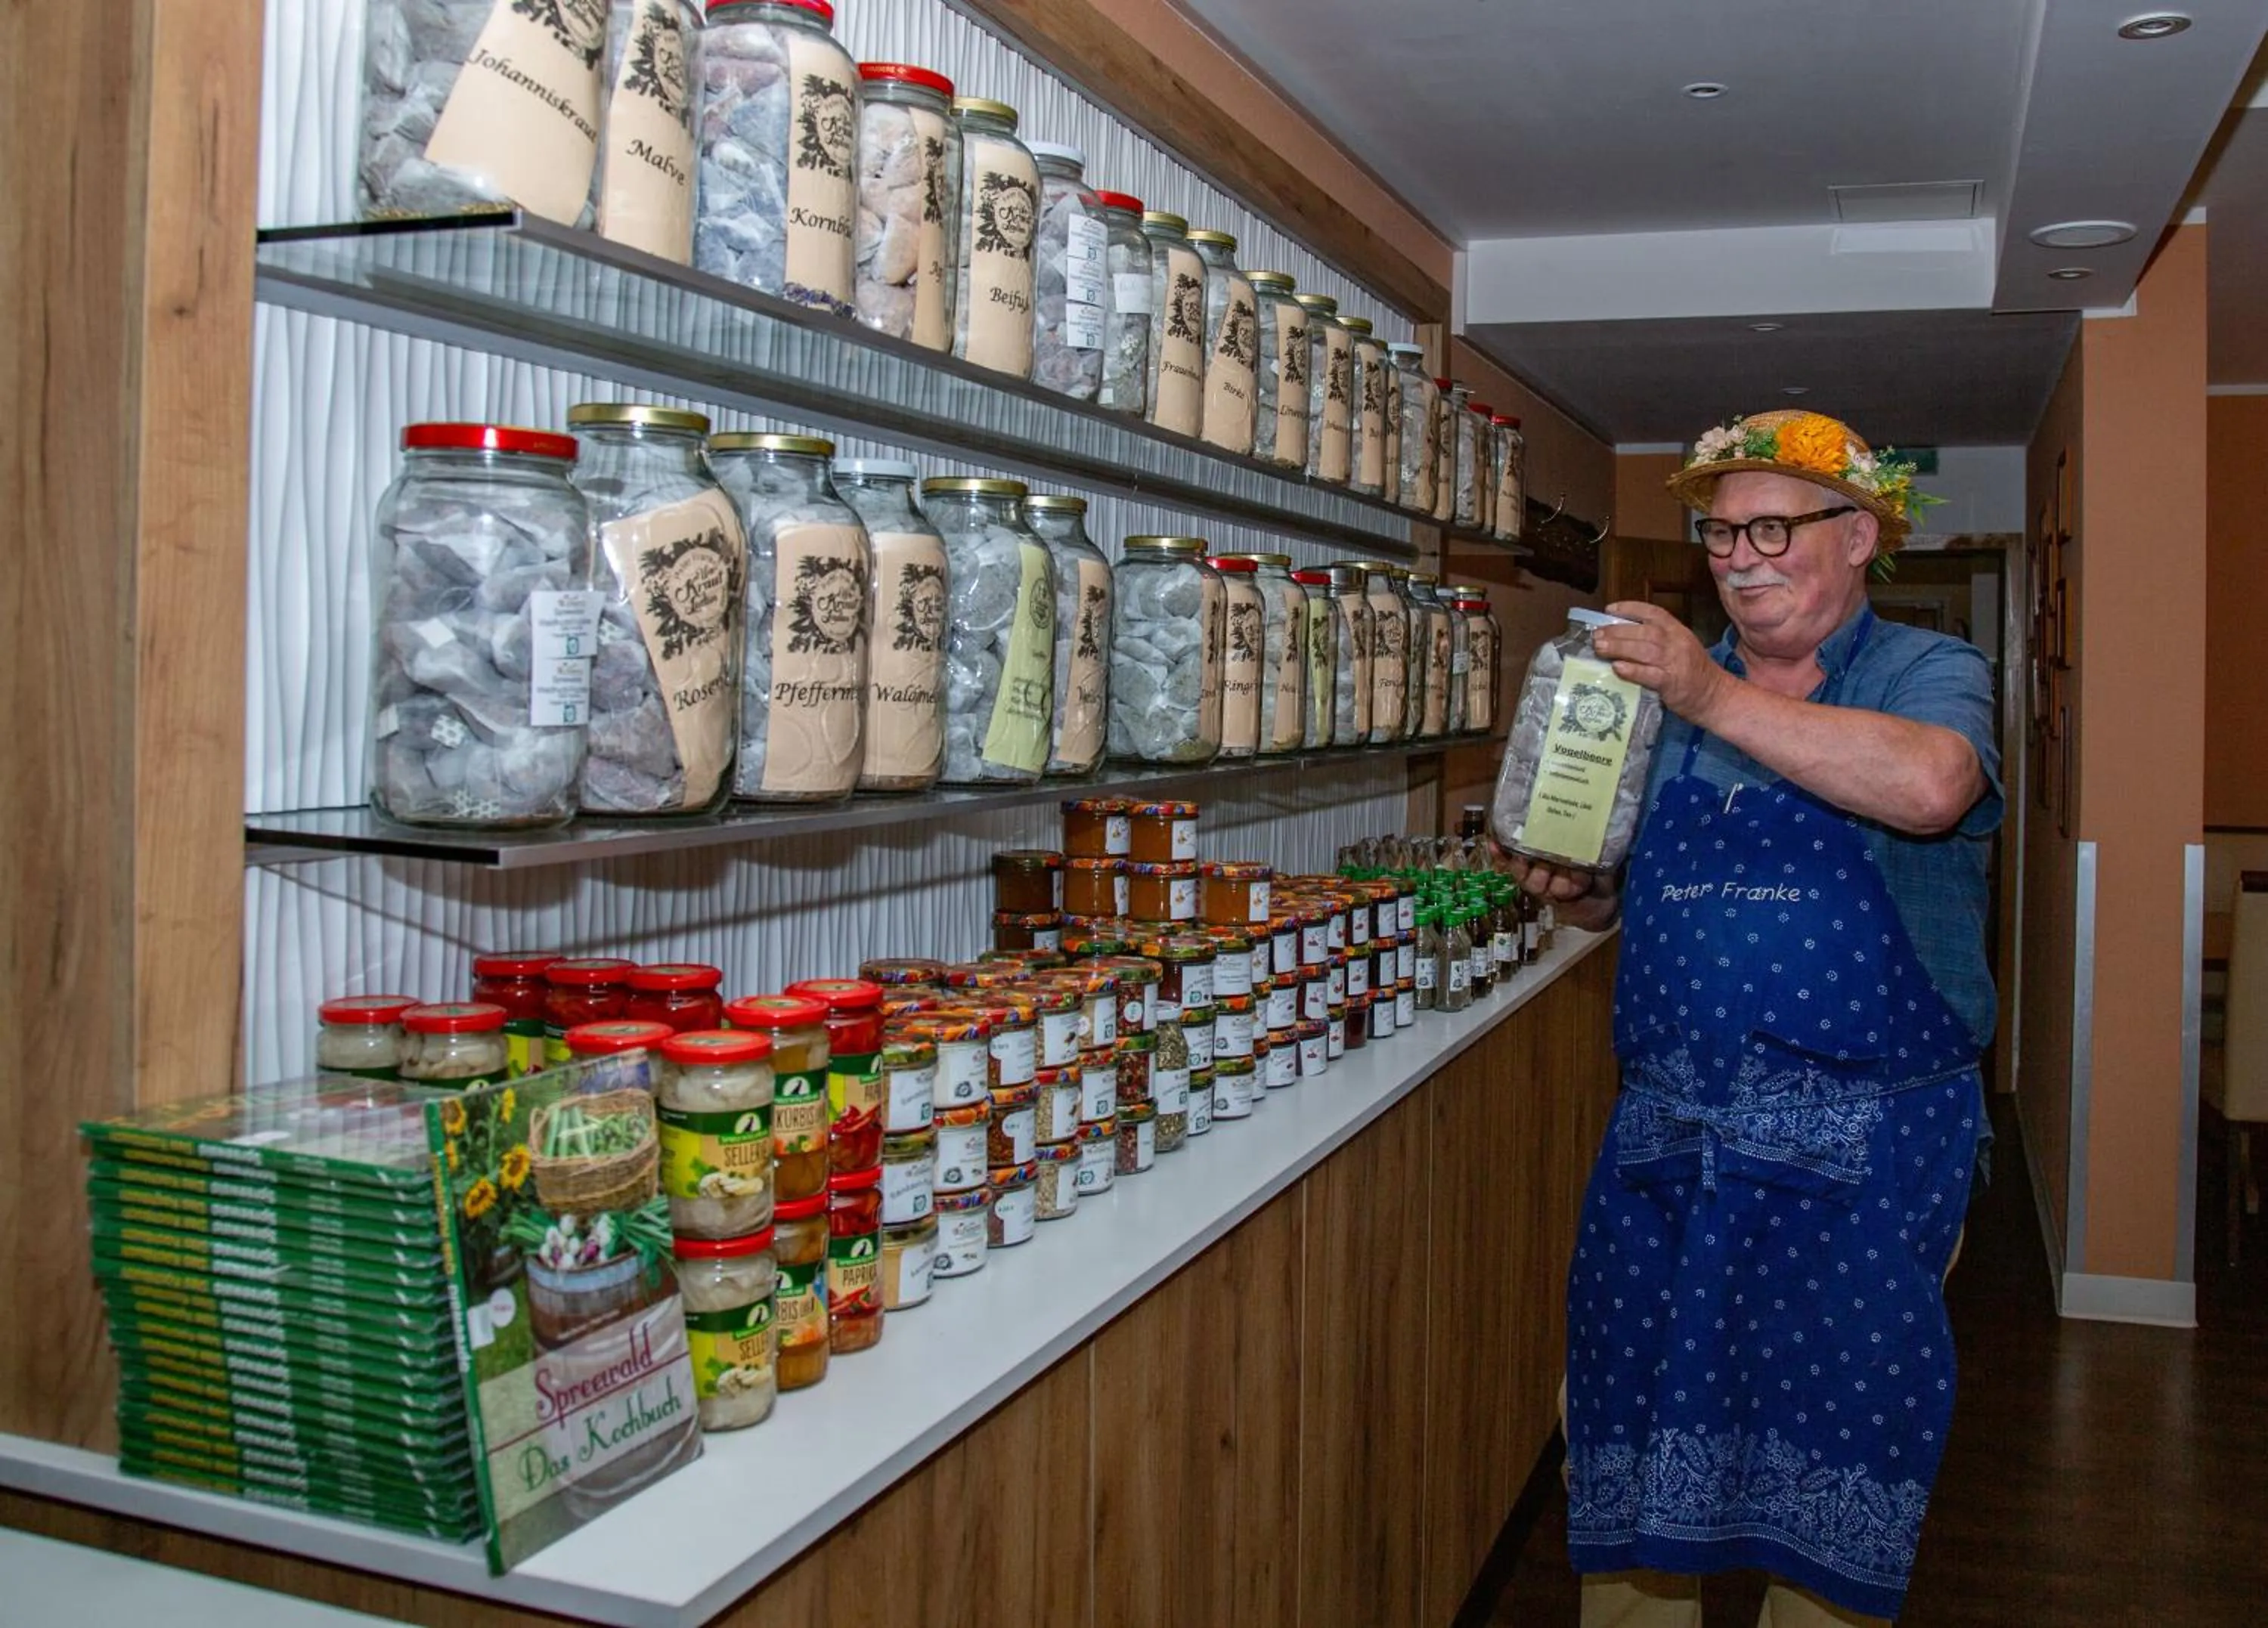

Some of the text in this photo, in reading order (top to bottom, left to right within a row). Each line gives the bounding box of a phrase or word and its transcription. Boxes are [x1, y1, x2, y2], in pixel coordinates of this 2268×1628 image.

[626, 139, 685, 186] Malve
[1662, 882, 1801, 902] Peter Franke
[534, 1323, 653, 1430] Spreewald
[519, 1375, 681, 1493] Das Kochbuch
